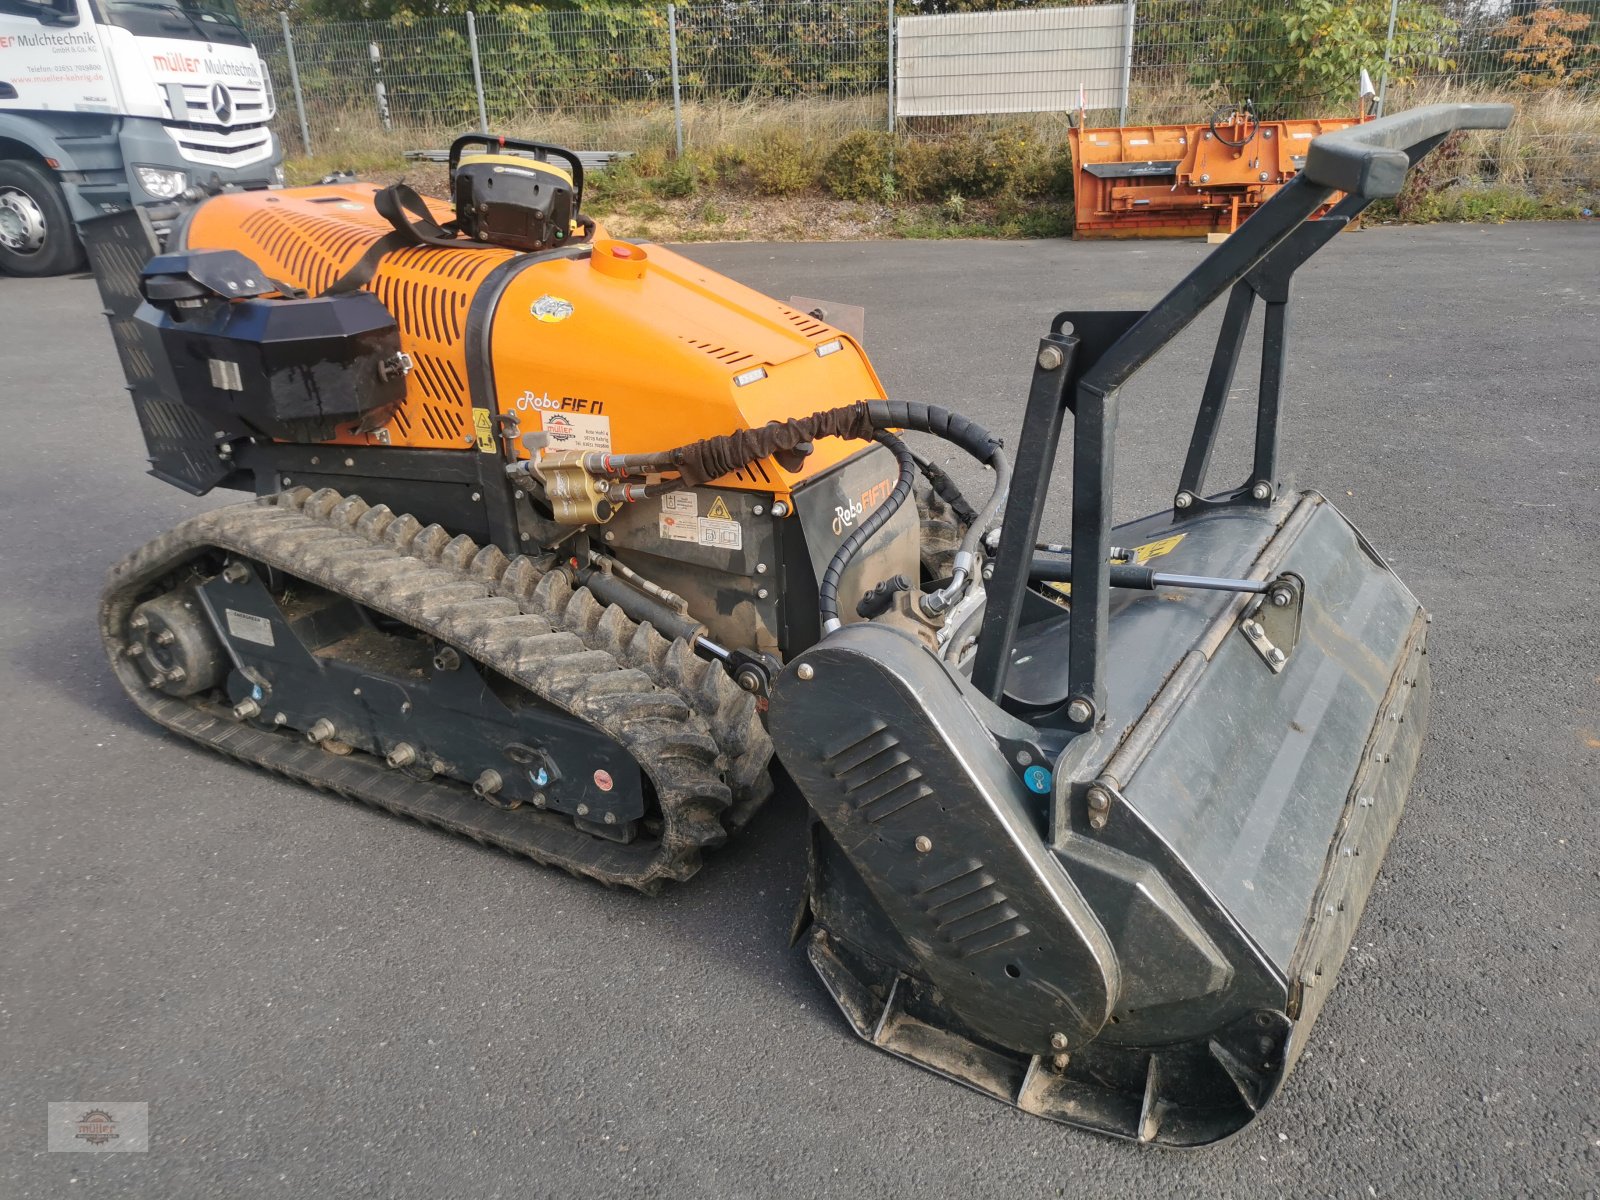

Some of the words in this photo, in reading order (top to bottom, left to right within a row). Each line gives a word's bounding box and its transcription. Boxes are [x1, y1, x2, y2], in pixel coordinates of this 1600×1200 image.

[17, 31, 96, 47] Mulchtechnik
[153, 52, 200, 73] müller
[204, 58, 259, 78] Mulchtechnik
